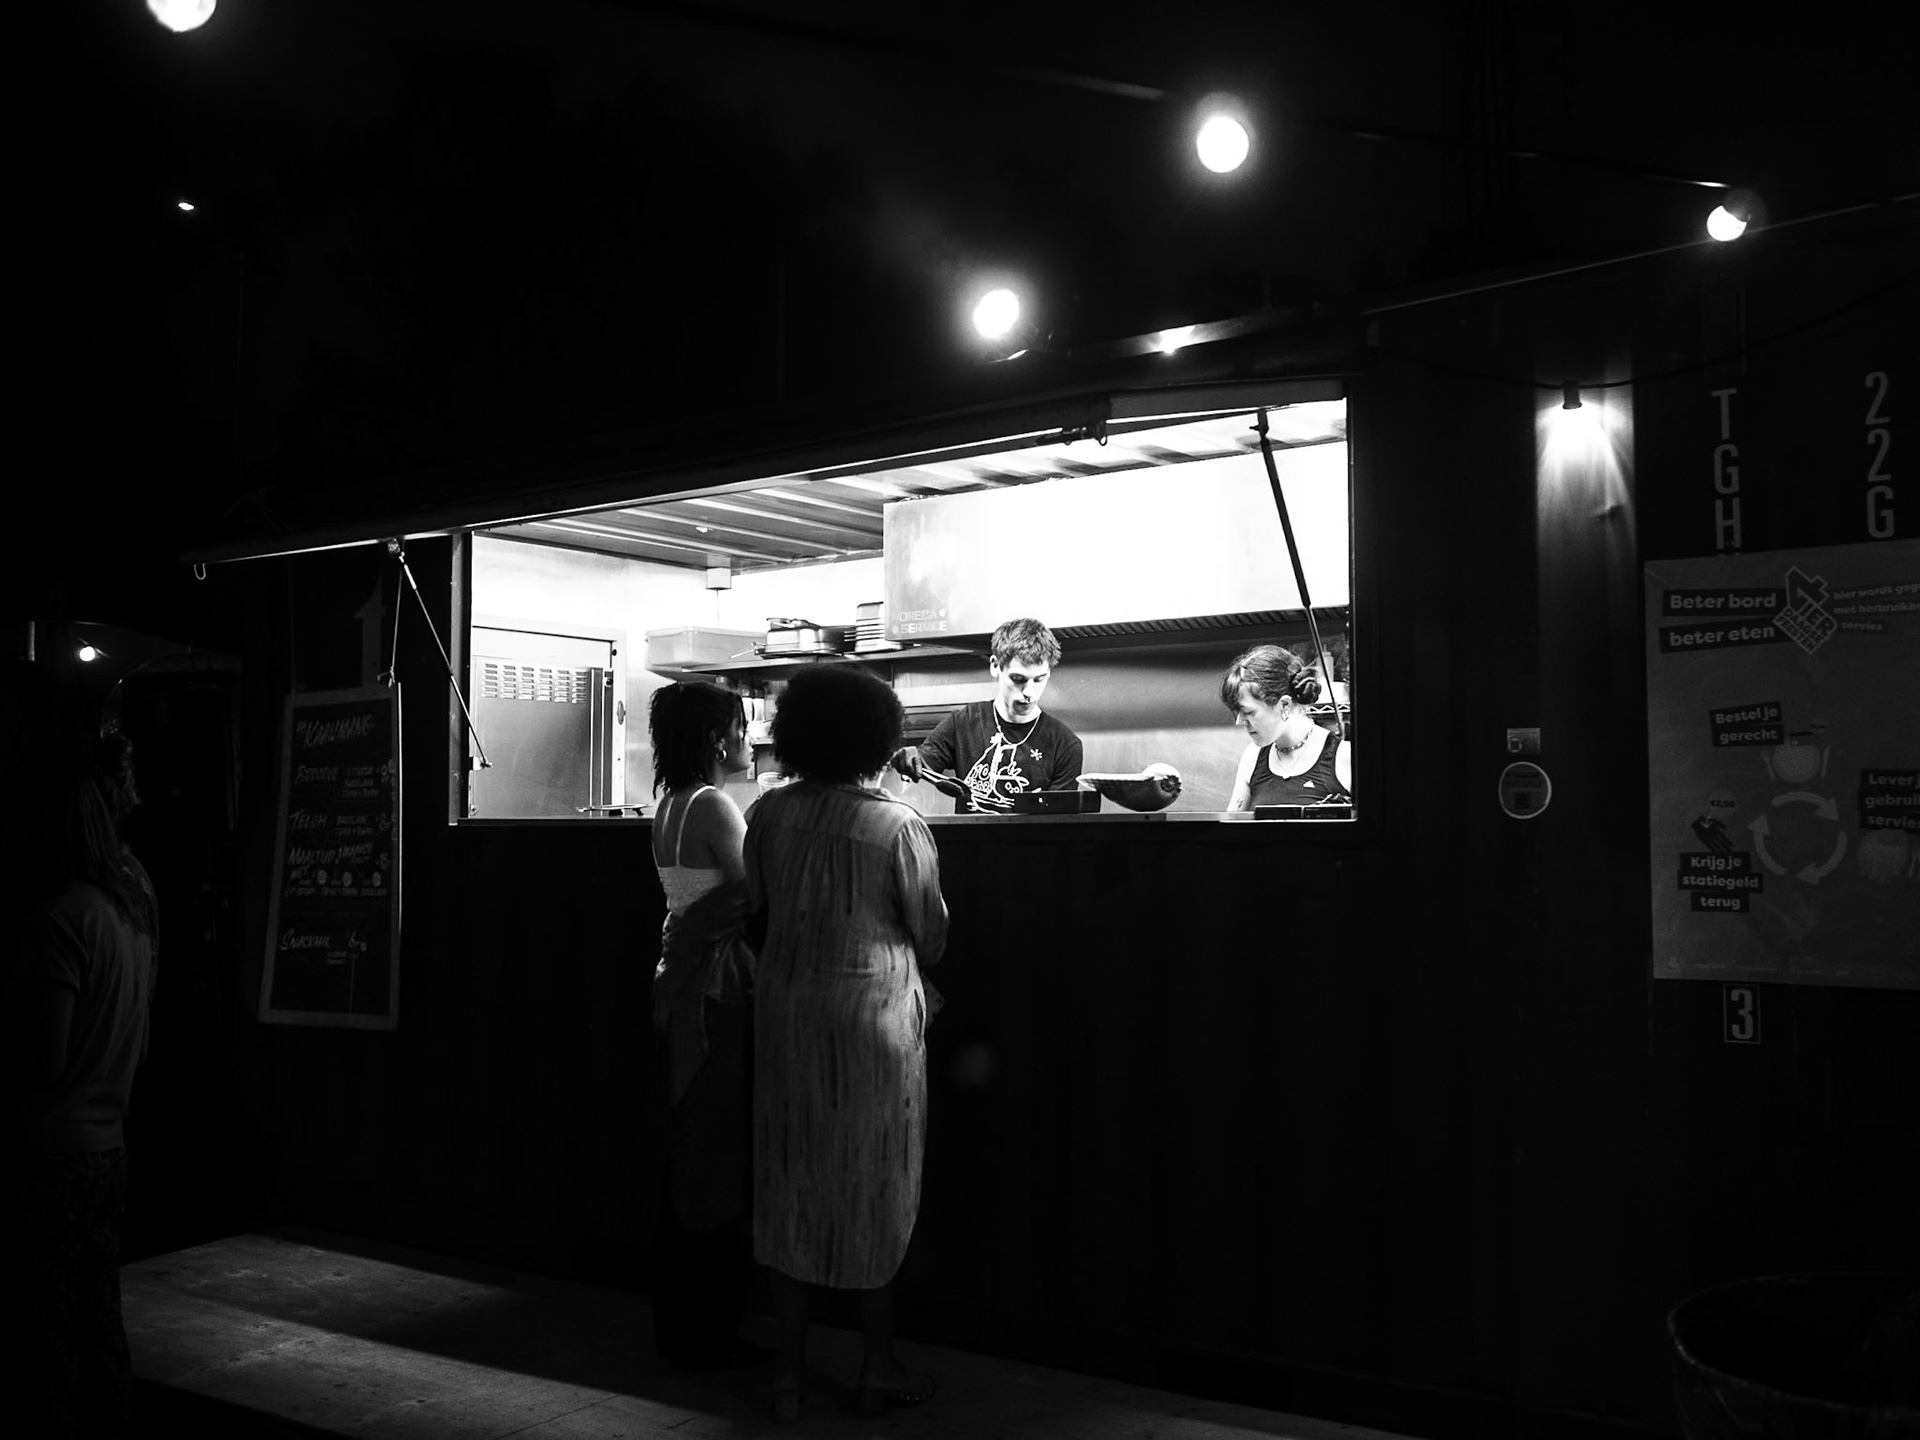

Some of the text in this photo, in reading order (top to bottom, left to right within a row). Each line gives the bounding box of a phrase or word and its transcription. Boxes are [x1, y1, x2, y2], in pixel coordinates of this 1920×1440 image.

[1669, 593, 1777, 610] Beter bord
[1669, 625, 1775, 647] beter eten
[1715, 706, 1779, 725] Bestel je
[1720, 729, 1779, 745] gerecht
[1868, 773, 1914, 786] Lever
[1690, 855, 1742, 871] Krijg je
[1682, 874, 1759, 890] statiegeld
[1699, 895, 1741, 911] terug
[1730, 987, 1755, 1041] 3
